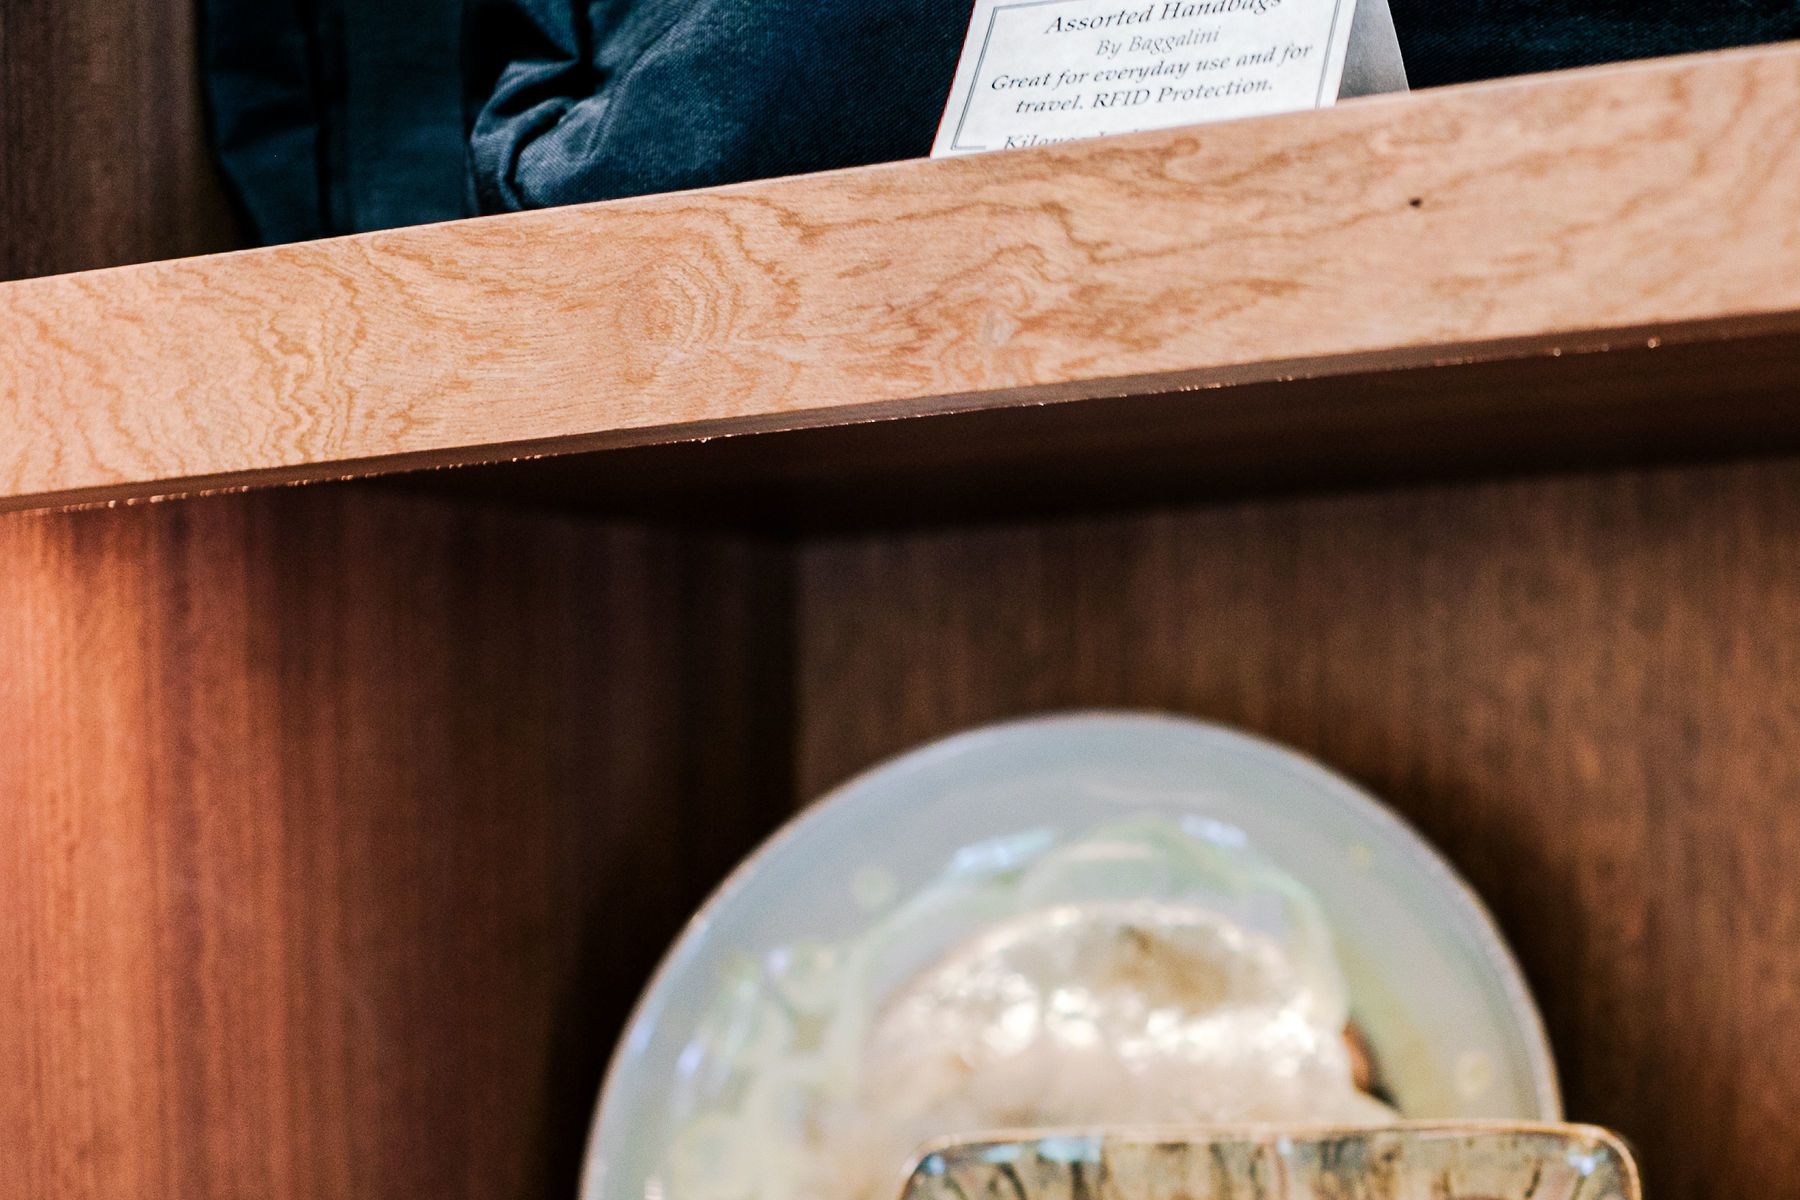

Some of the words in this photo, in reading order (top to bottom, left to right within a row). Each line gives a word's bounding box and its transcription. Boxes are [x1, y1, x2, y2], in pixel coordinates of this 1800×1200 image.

[1043, 4, 1154, 34] Assorted
[1096, 39, 1122, 59] By
[1127, 25, 1222, 55] Baggalini
[991, 71, 1052, 91] Great
[1054, 68, 1090, 90] for
[1093, 59, 1190, 84] everyday
[1195, 55, 1231, 73] use
[1235, 48, 1278, 67] and
[1278, 42, 1314, 65] for
[1015, 94, 1084, 114] travel.
[1092, 87, 1151, 110] RFID
[1155, 76, 1274, 105] Protection.
